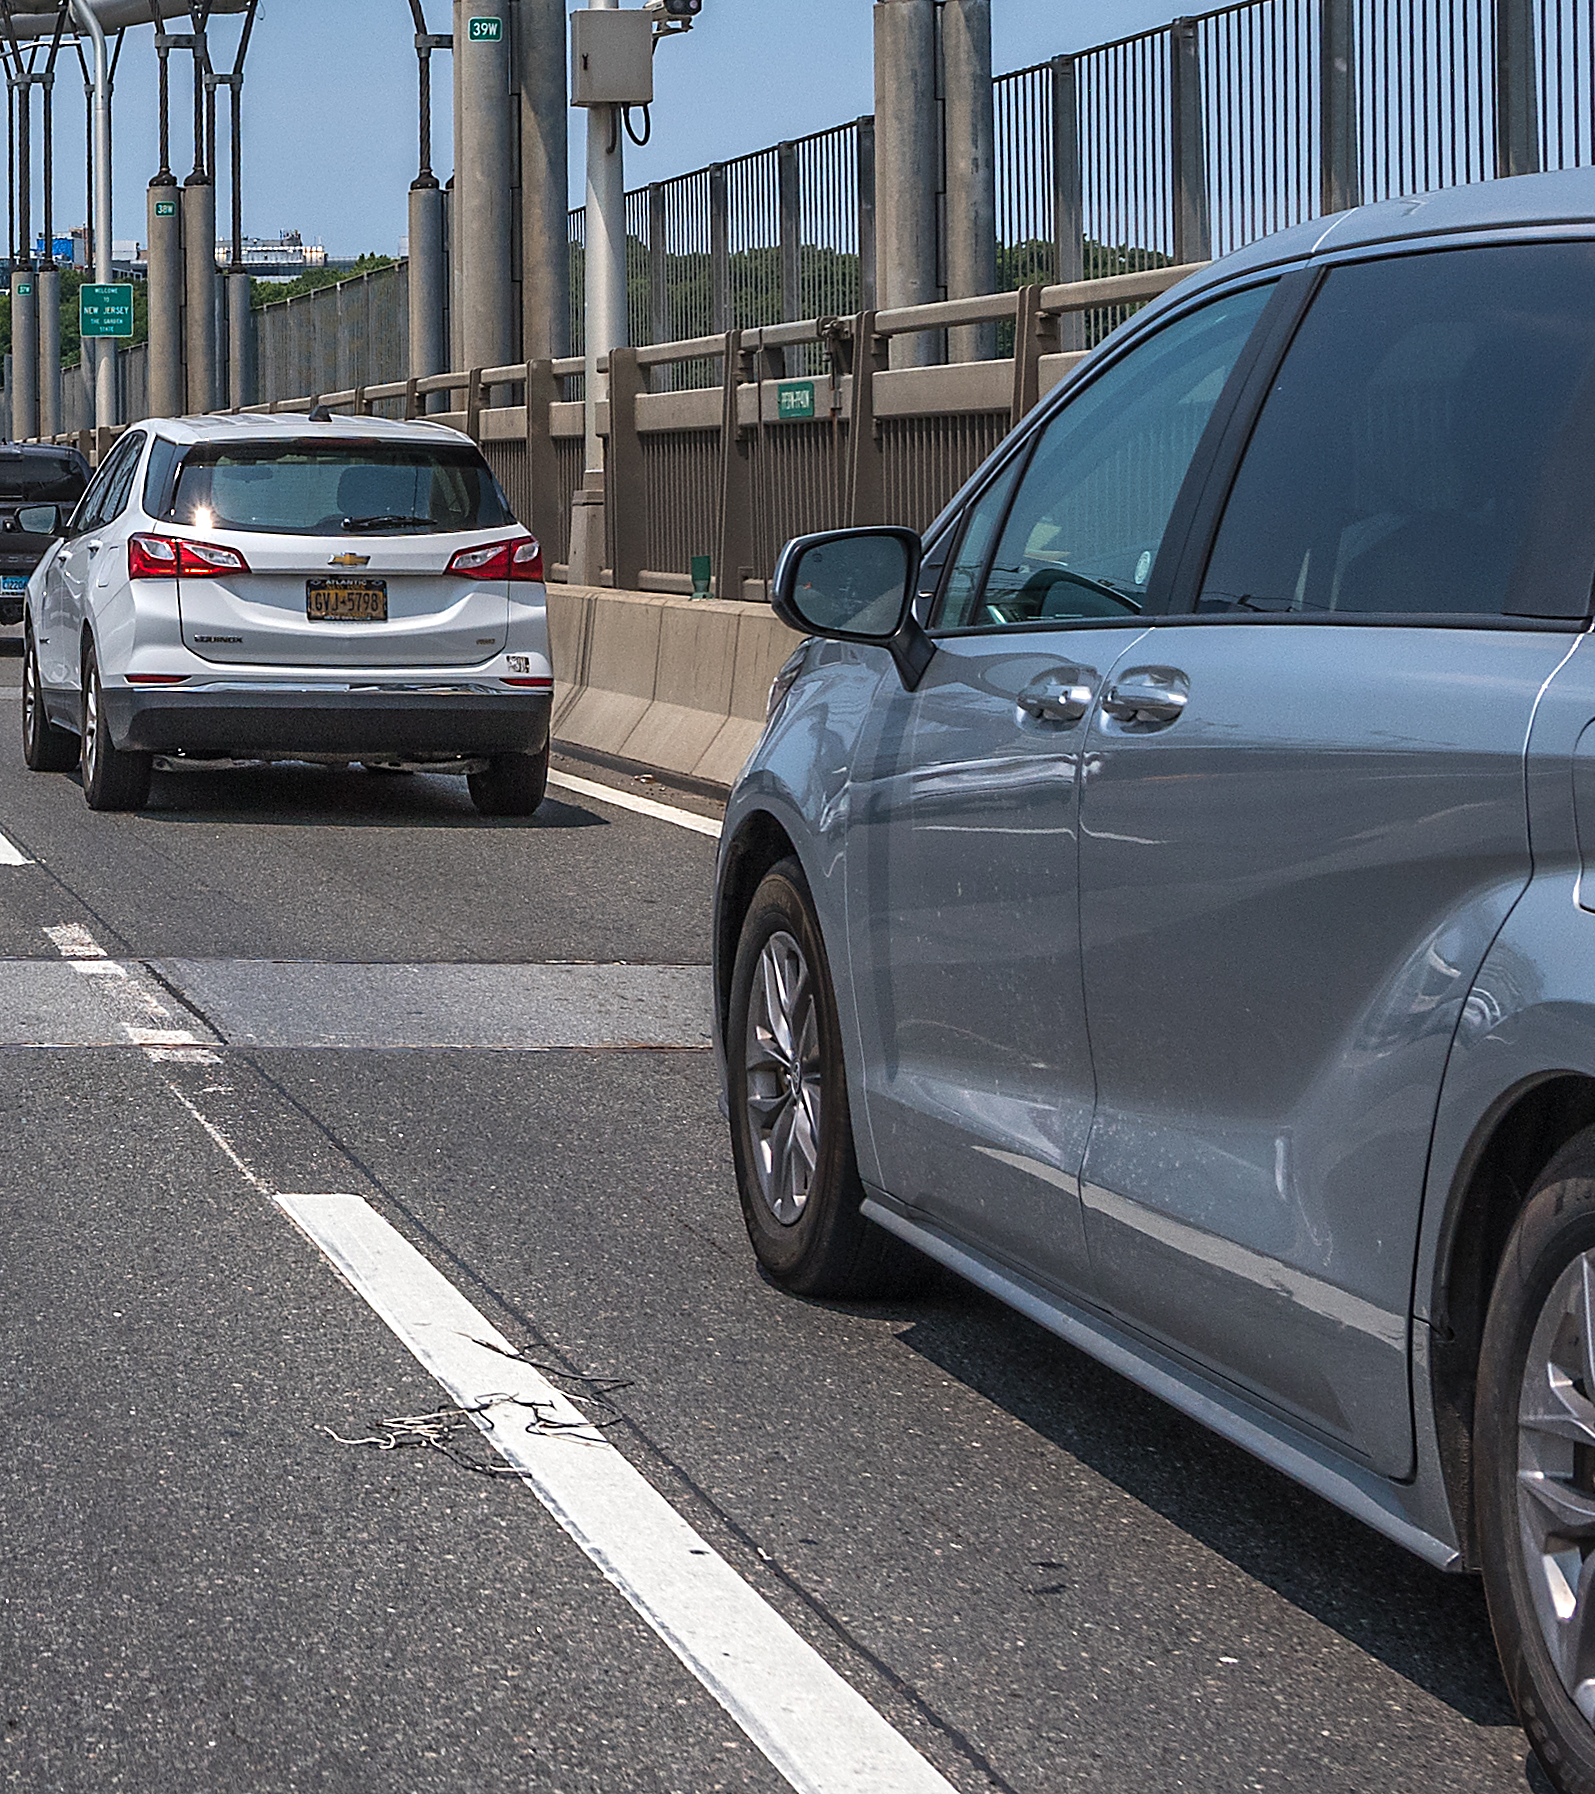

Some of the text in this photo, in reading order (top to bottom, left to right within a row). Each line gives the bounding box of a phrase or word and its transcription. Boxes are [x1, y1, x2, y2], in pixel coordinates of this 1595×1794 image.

[472, 22, 498, 36] 39W
[157, 204, 173, 214] 38W
[83, 306, 129, 315] NEW JERSEY
[194, 635, 243, 644] EQUINOX
